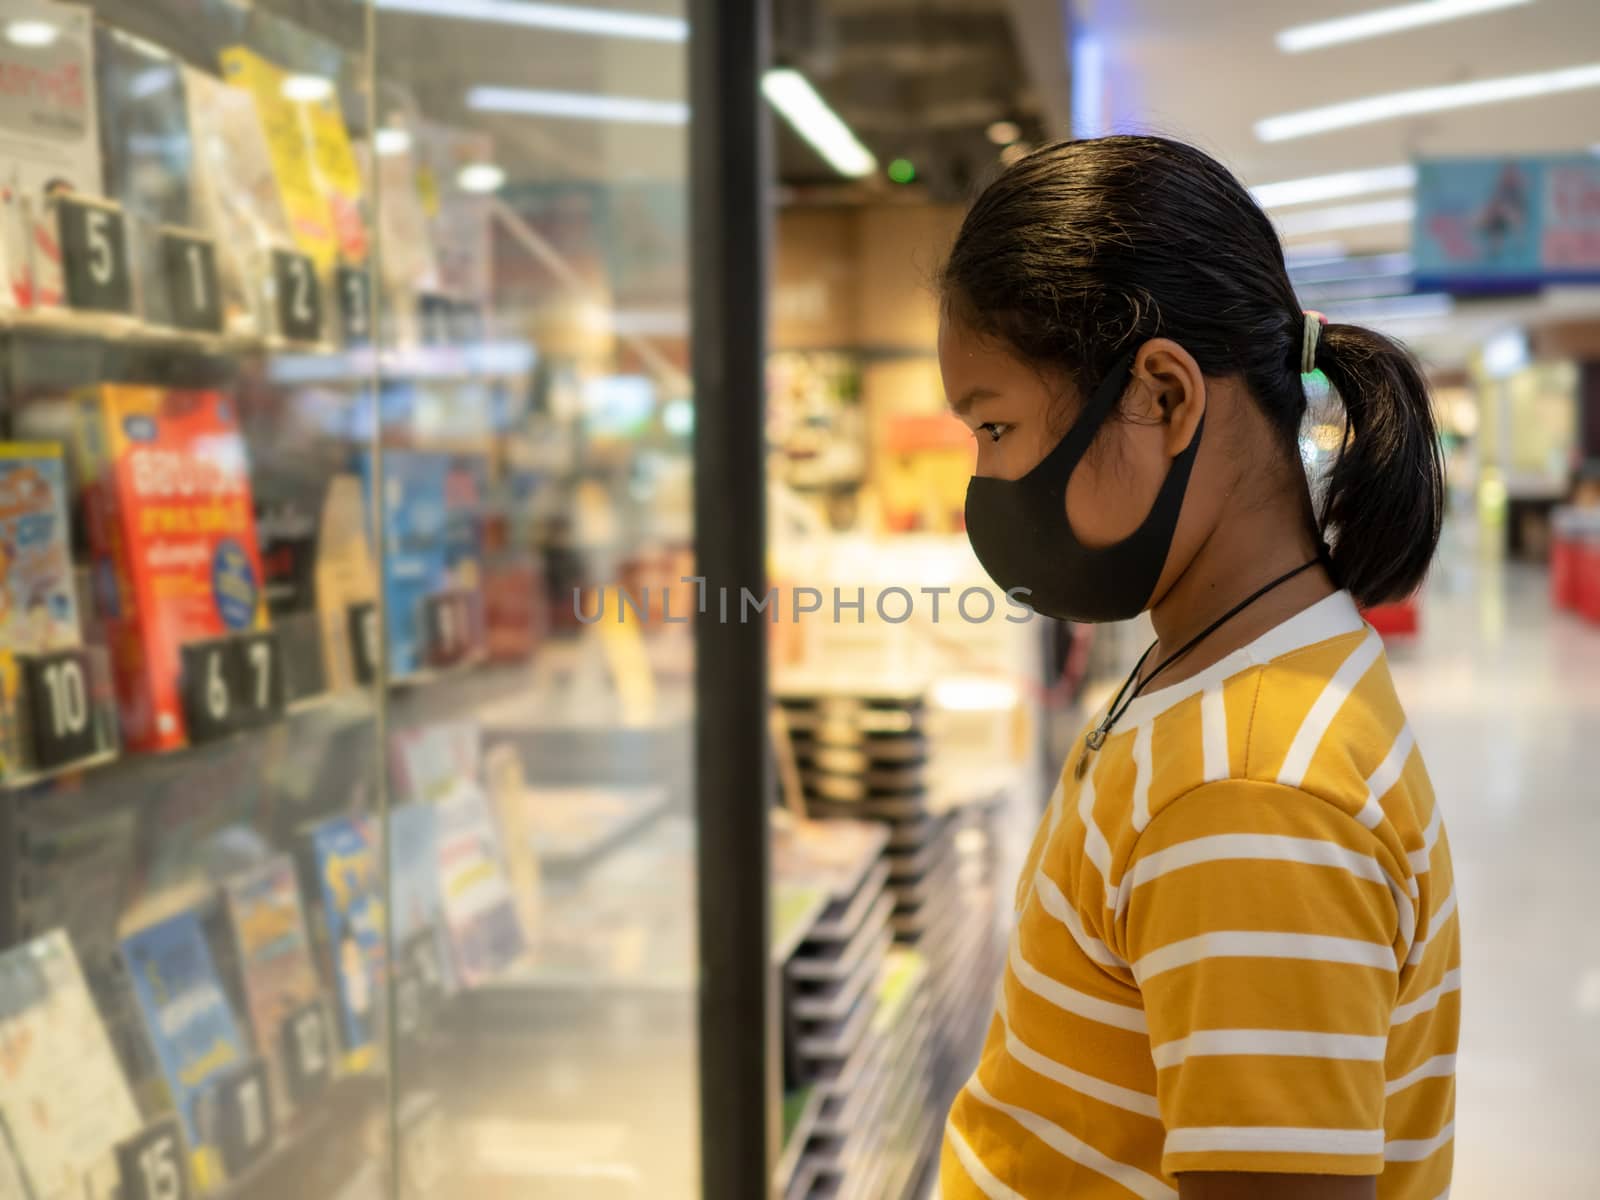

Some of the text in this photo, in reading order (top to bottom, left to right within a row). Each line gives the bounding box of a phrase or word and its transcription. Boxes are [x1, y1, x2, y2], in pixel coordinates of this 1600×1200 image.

[85, 210, 113, 285] 5
[186, 246, 207, 310] 1
[289, 259, 311, 321] 2
[43, 660, 87, 738] 10
[206, 652, 229, 720] 6
[248, 641, 271, 708] 7
[139, 1135, 180, 1200] 15
